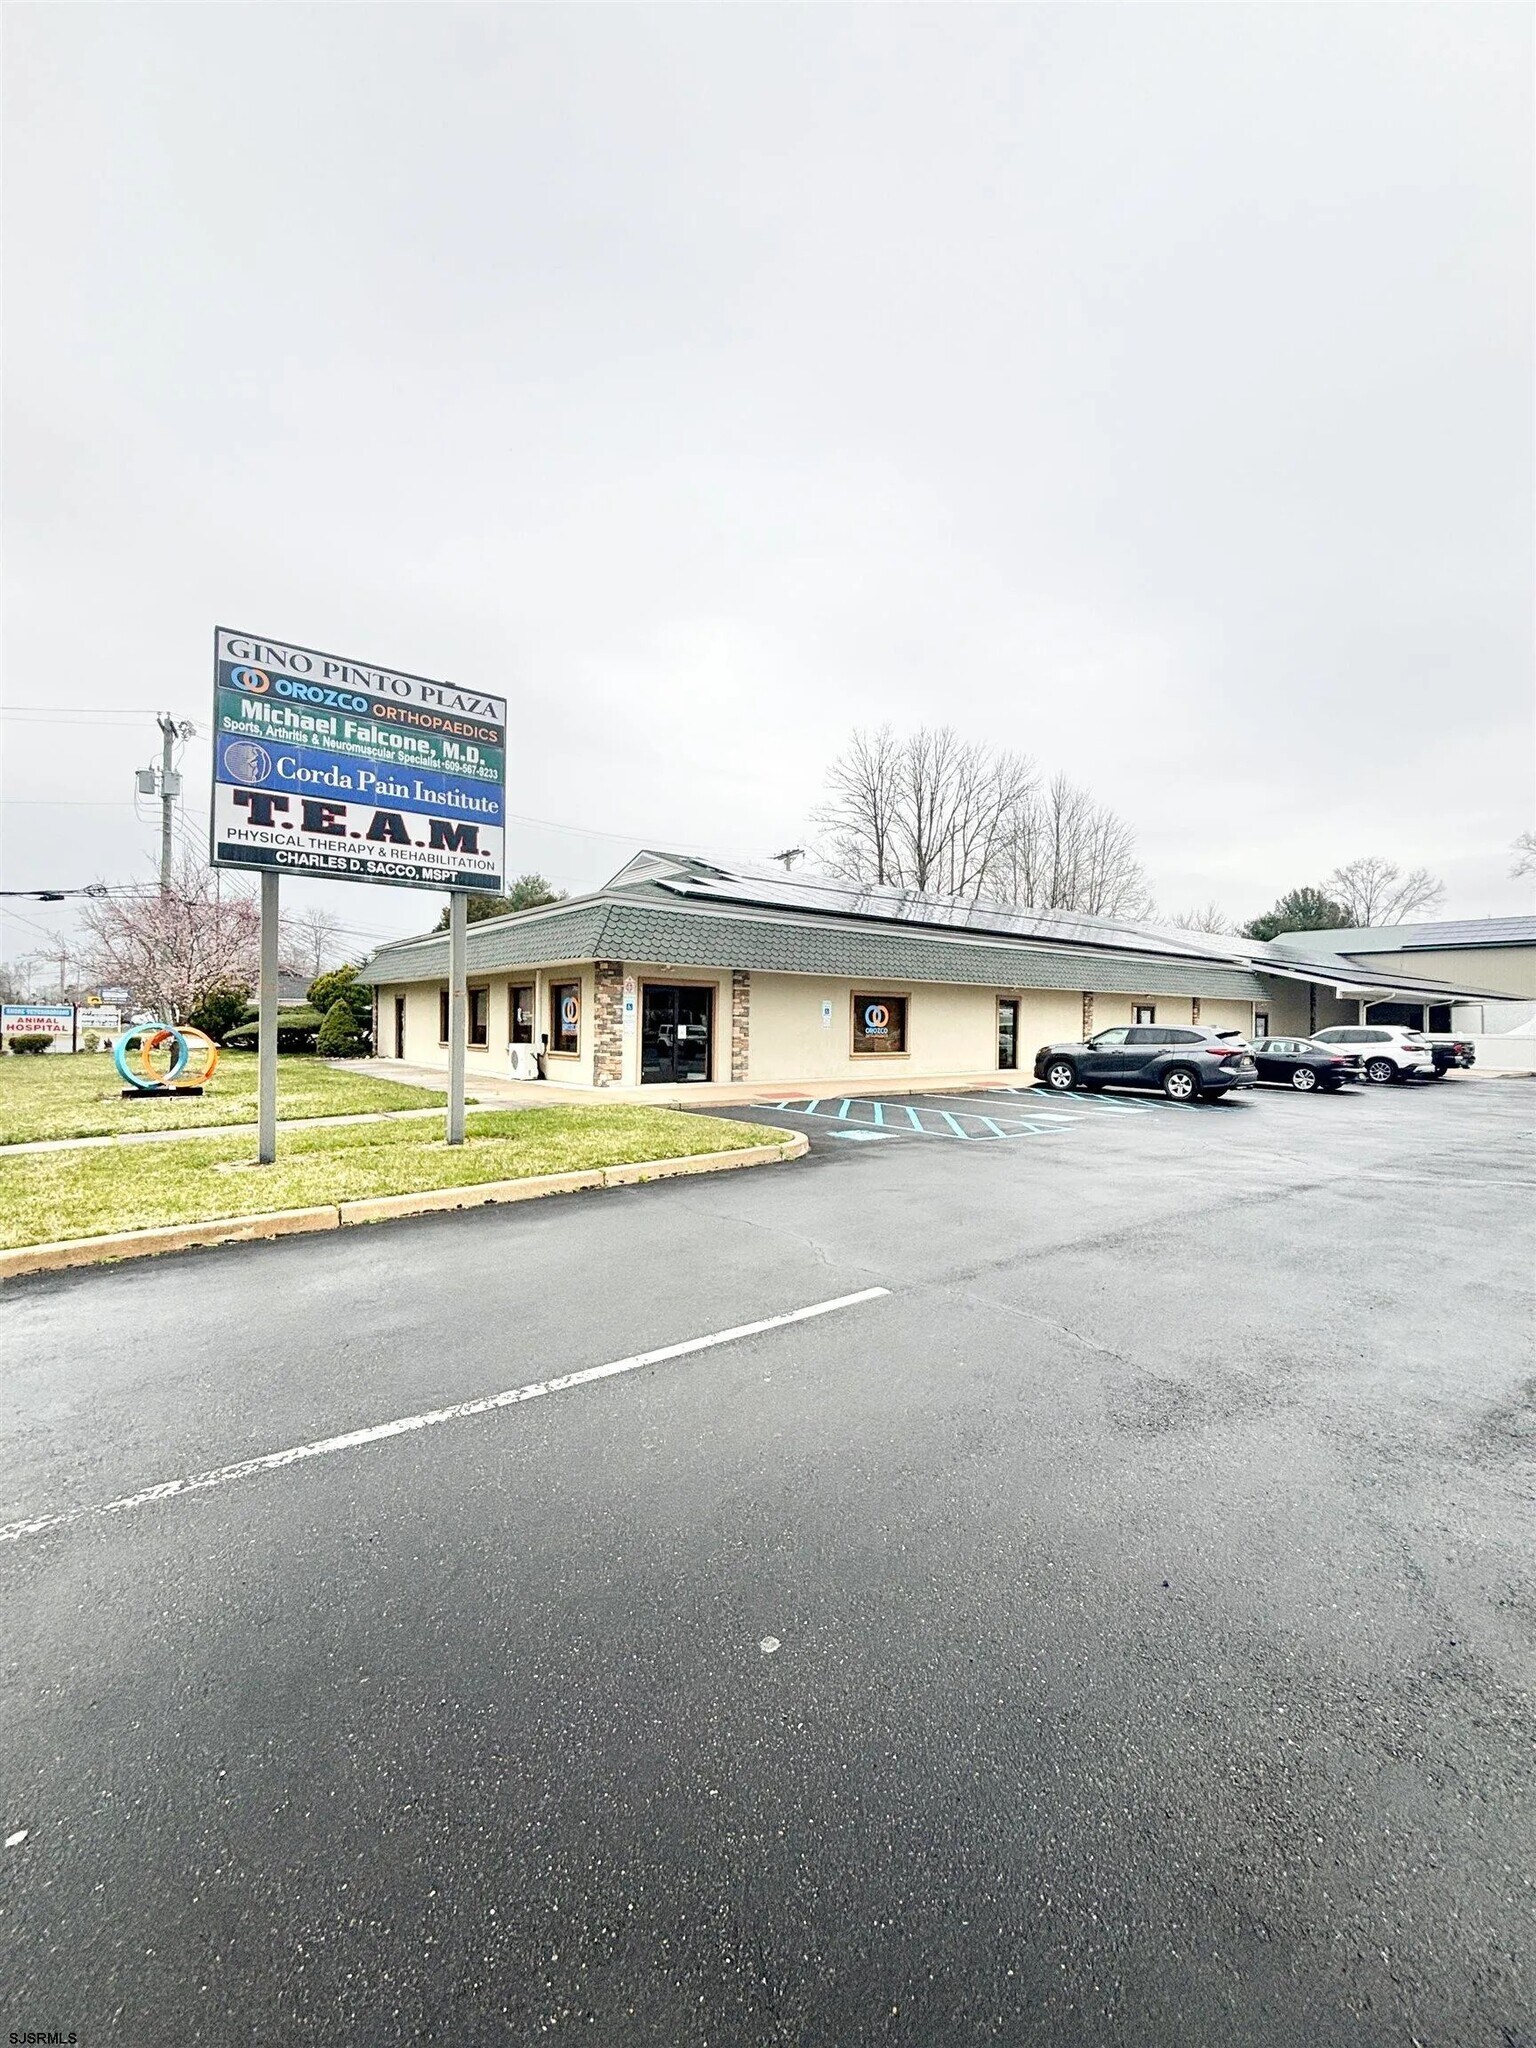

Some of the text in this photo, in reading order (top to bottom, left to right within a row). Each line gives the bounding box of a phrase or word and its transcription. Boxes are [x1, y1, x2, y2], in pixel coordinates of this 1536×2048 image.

[227, 639, 498, 719] GINO PINTO PLAZA
[223, 716, 263, 736] Sports,
[265, 725, 308, 743] Arthritis
[312, 733, 320, 745] &
[323, 736, 395, 760] Neuromuscular
[241, 699, 486, 765] Michael Falcone, M.D.
[275, 679, 498, 742] OROZCO ORTHOPAEDICS
[276, 756, 499, 813] Corda Pain Institute
[227, 828, 495, 871] PHYSICAL THERAPY & REHABILITATION
[233, 789, 491, 857] T.E.A.M.
[275, 851, 458, 882] CHARLES D. SACCO, MSPT
[6, 1024, 69, 1032] HOSPITAL
